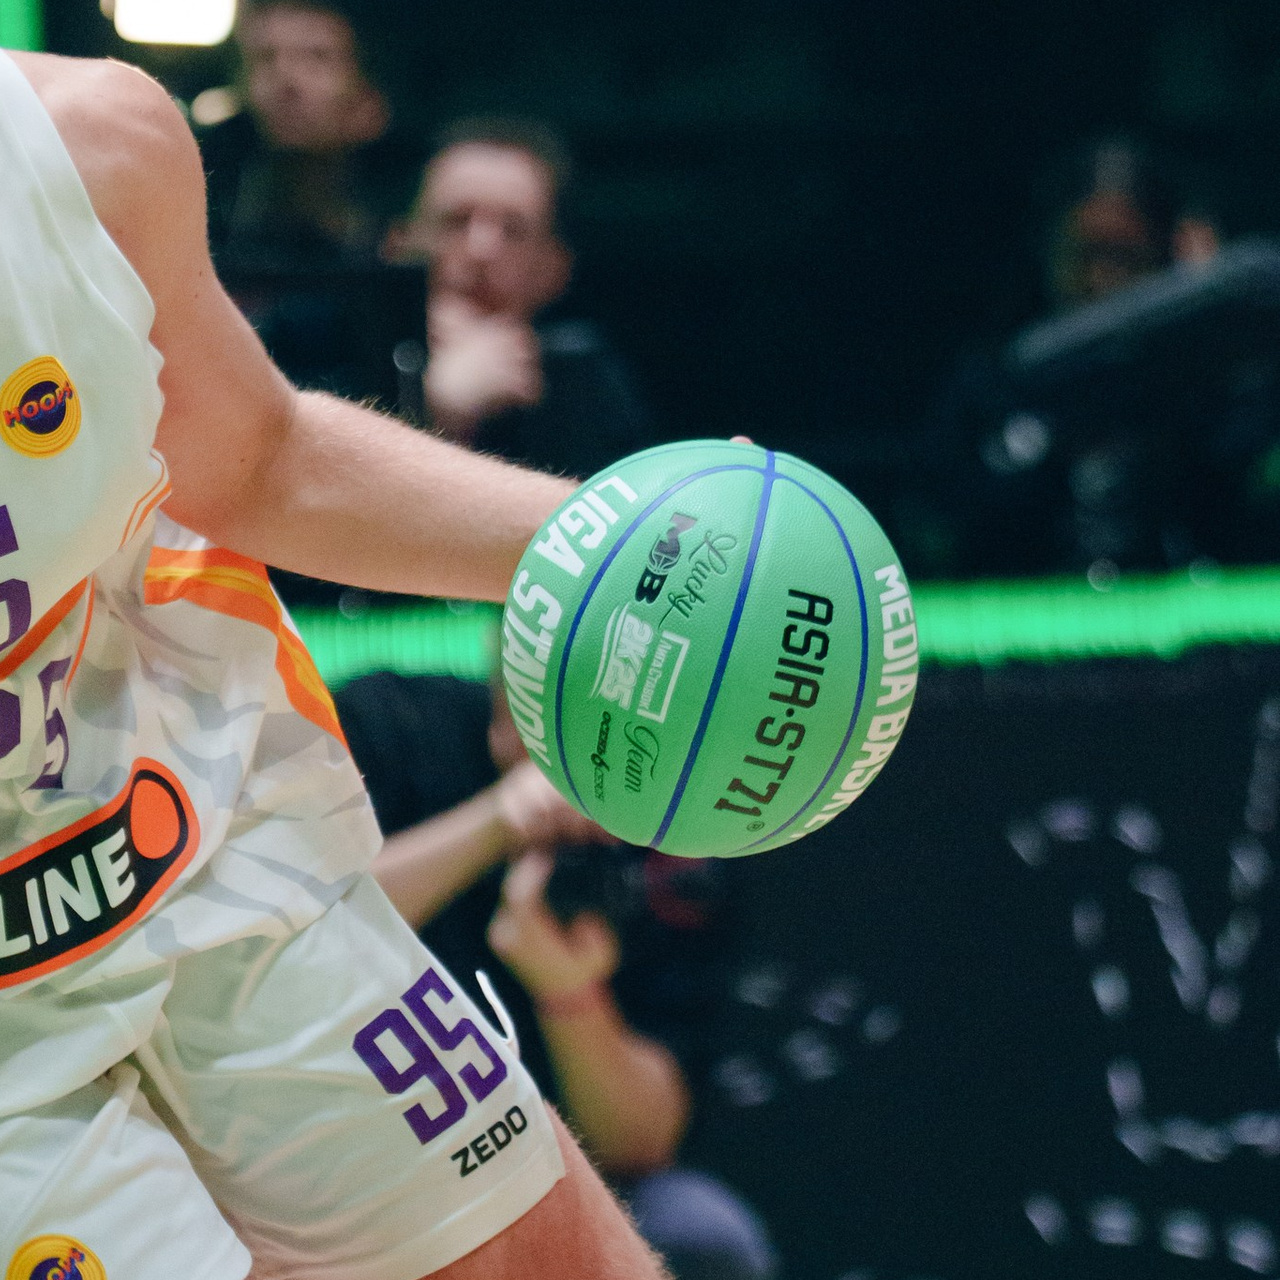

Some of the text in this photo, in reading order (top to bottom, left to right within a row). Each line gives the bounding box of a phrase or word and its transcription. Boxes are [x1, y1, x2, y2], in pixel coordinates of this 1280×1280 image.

[532, 475, 639, 578] LIGA
[873, 563, 920, 708] MEDIA
[352, 966, 508, 1146] 95
[450, 1104, 528, 1178] ZEDO
